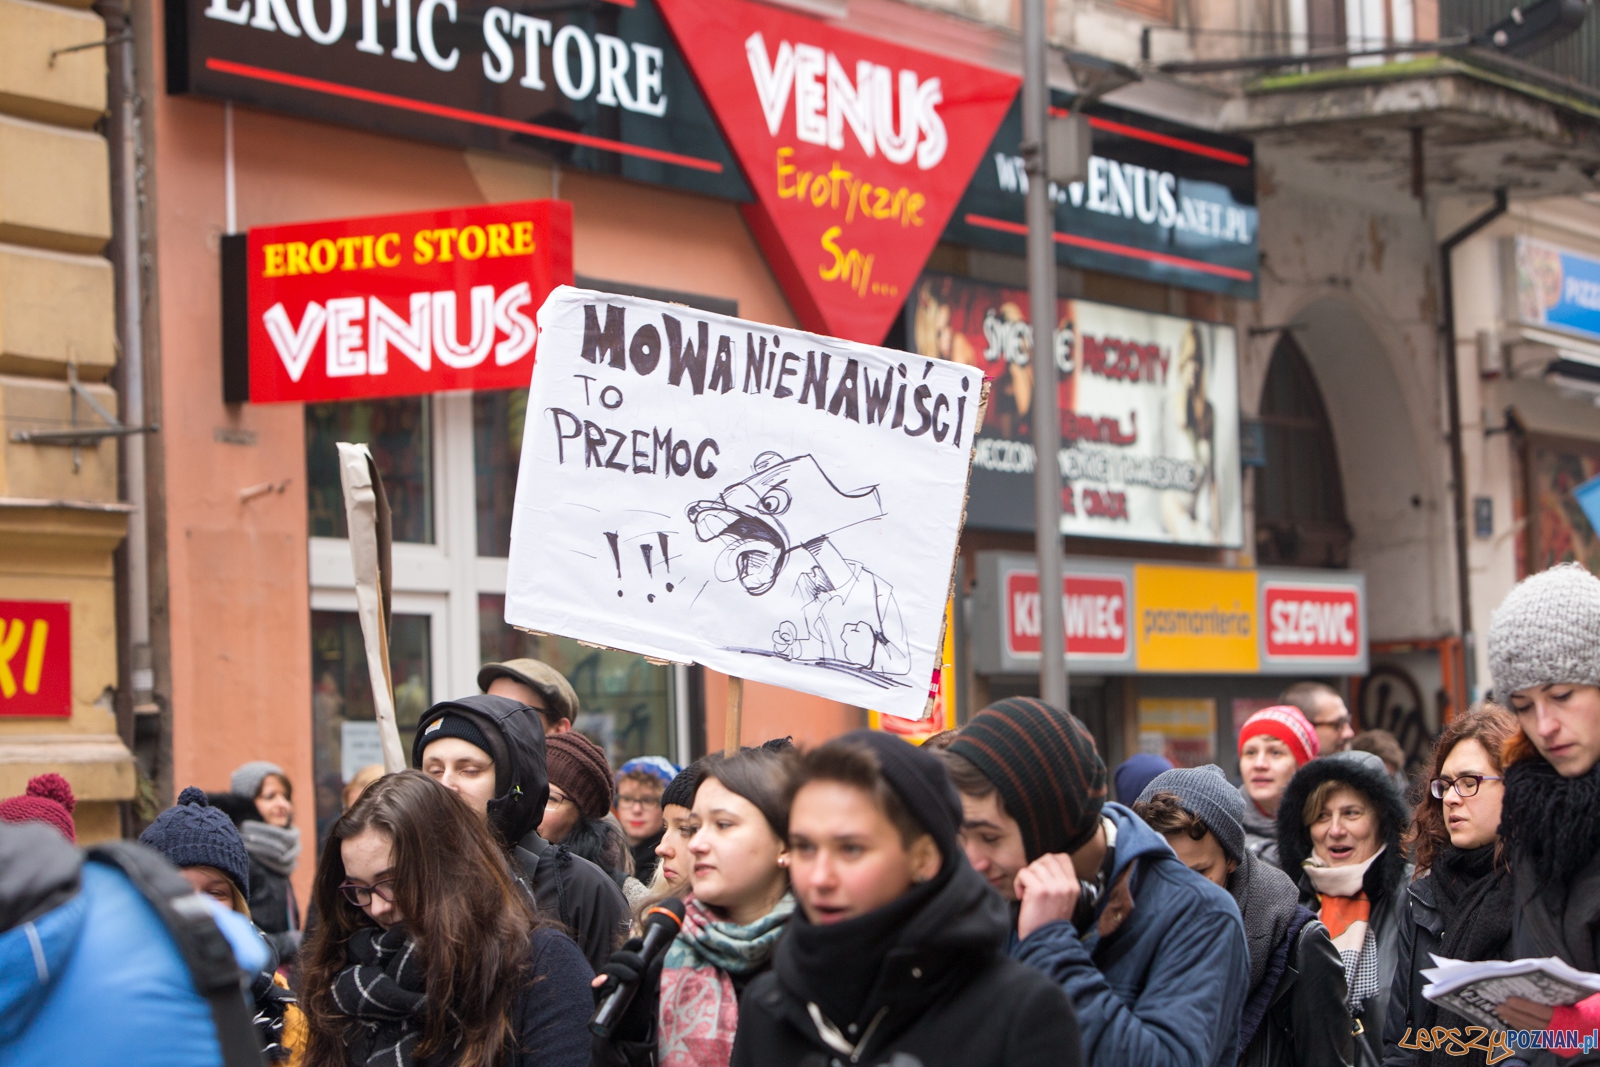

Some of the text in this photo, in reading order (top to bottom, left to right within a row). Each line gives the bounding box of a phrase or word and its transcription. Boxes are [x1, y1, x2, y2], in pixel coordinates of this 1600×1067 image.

[482, 6, 668, 118] STORE
[745, 31, 948, 170] VENUS
[776, 147, 926, 227] Erotyczne
[262, 221, 536, 278] EROTIC STORE
[263, 282, 538, 383] VENUS
[574, 374, 623, 410] TO
[544, 407, 721, 480] PRZEMOC
[1012, 590, 1124, 641] KWIEC
